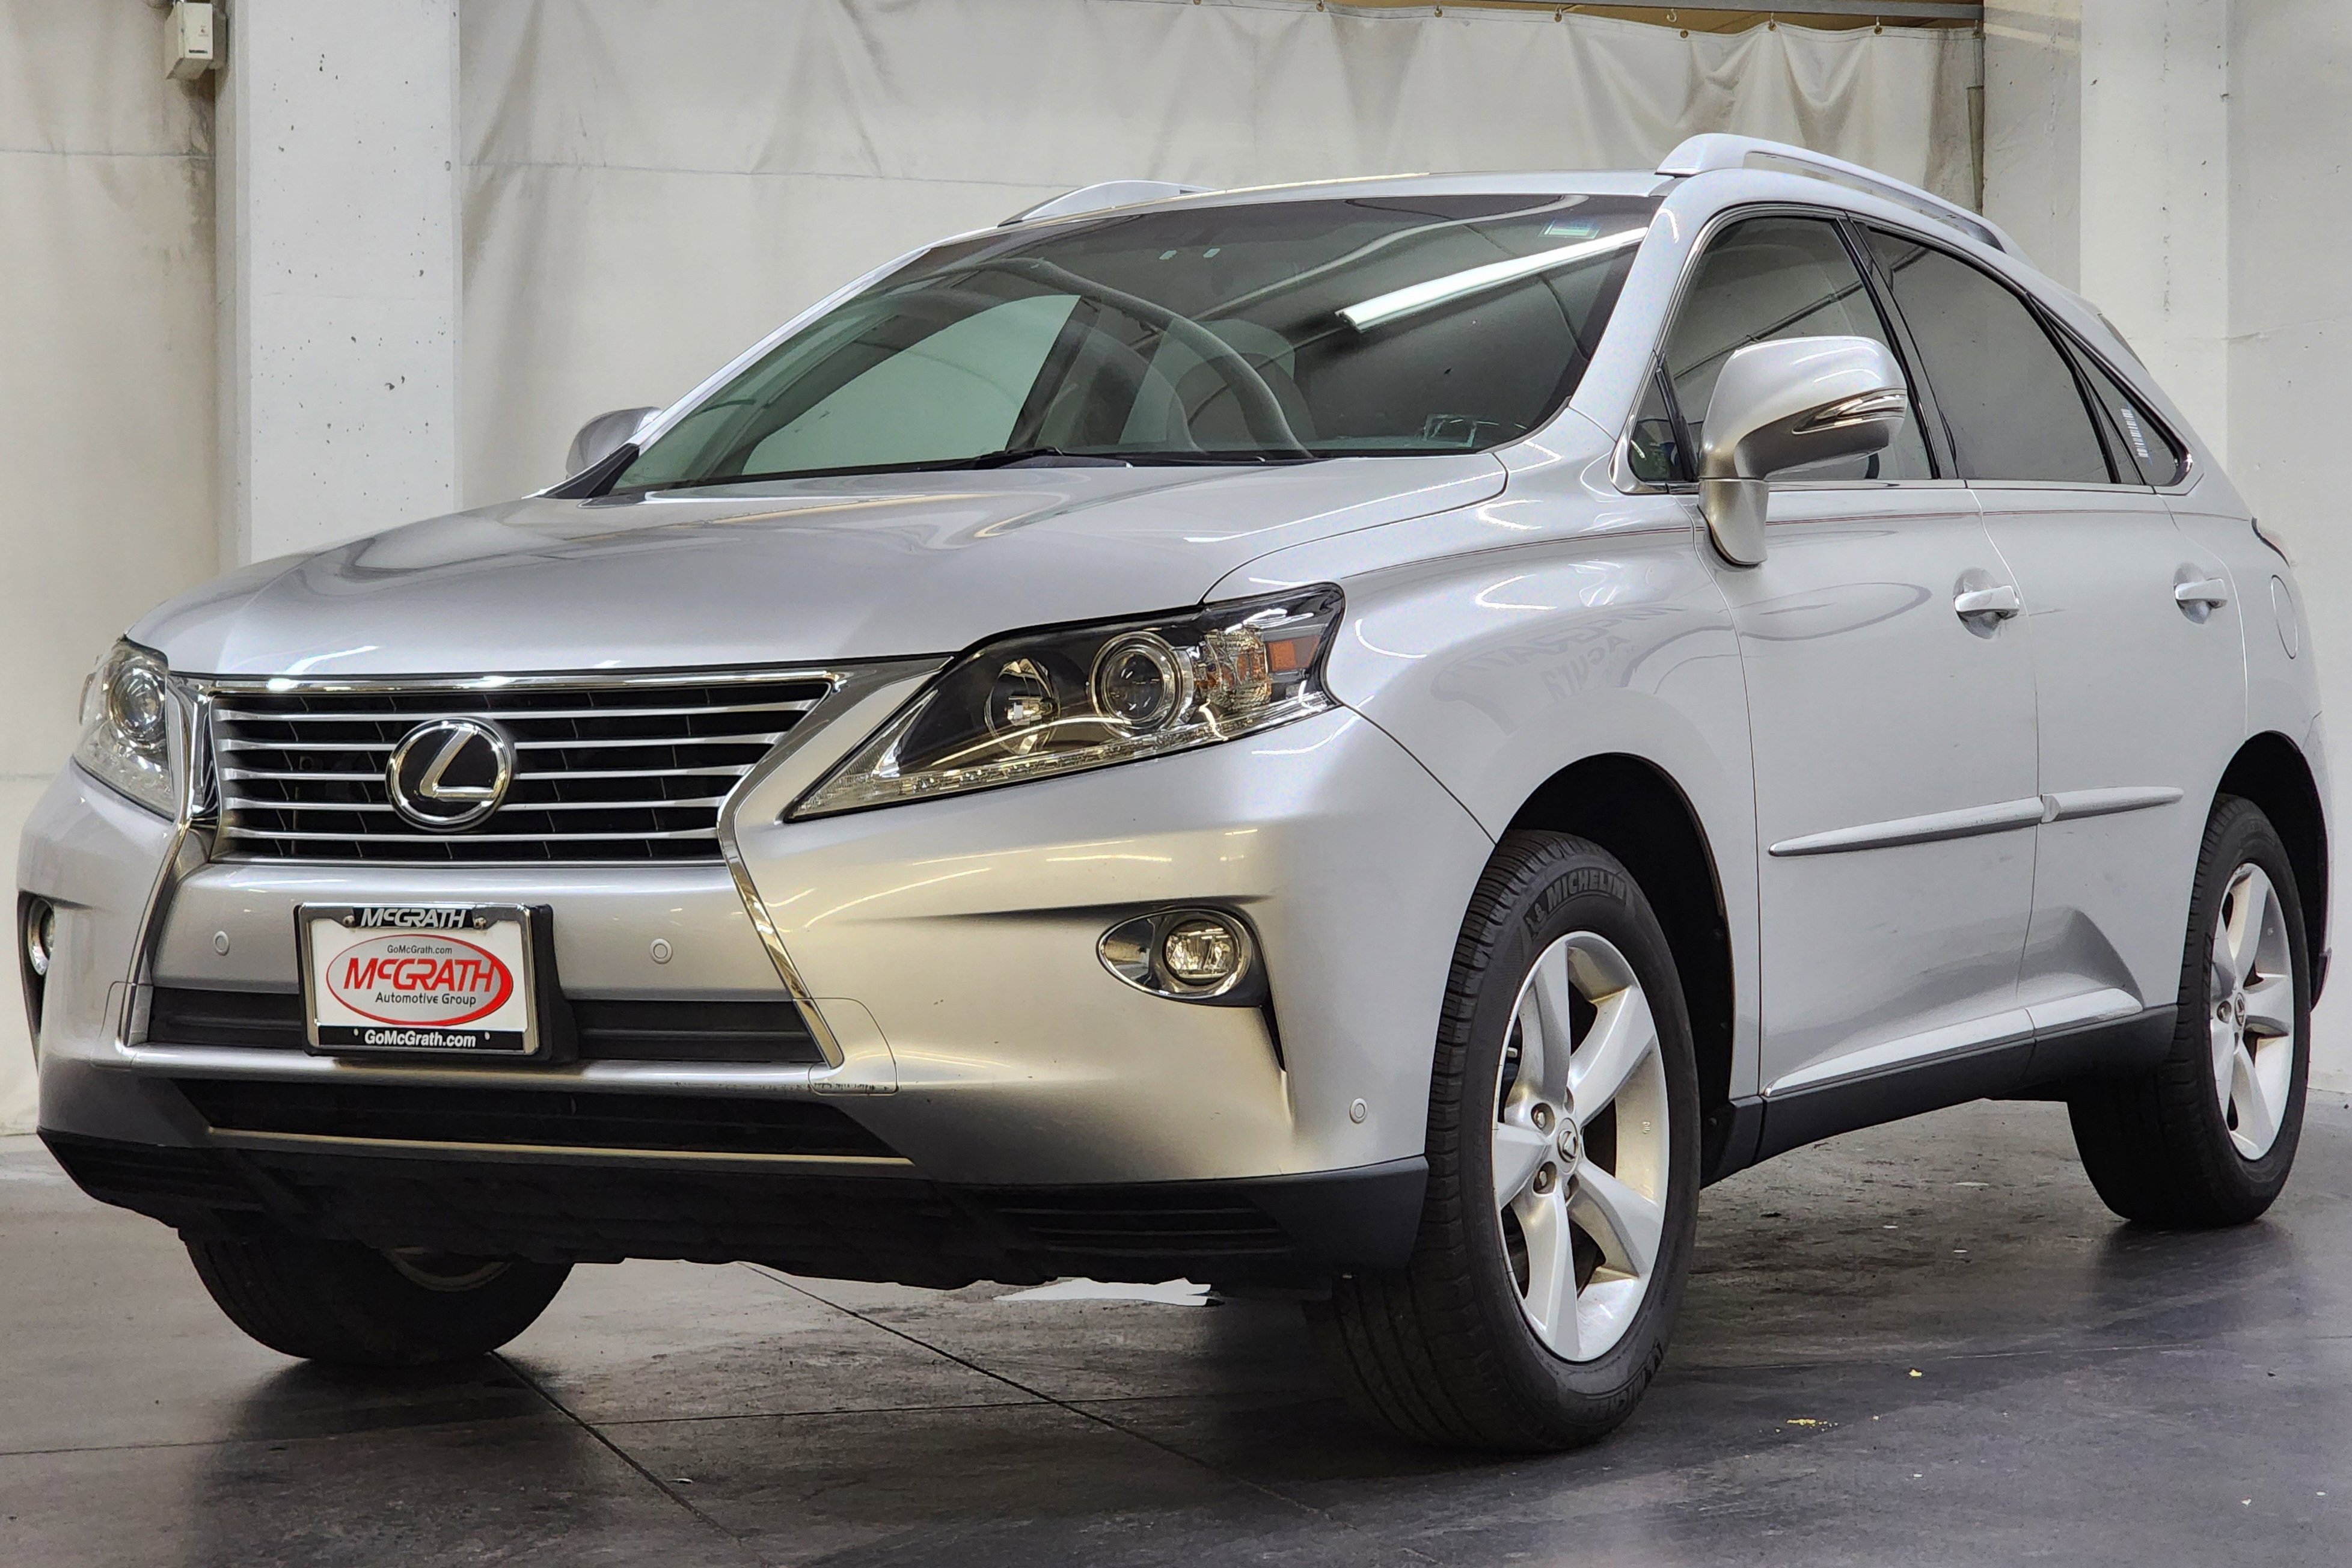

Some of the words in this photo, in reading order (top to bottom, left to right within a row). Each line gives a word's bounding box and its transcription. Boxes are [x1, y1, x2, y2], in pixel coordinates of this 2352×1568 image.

[1546, 869, 1626, 913] MICHELIN
[387, 945, 452, 955] GoMcGrath.com
[375, 992, 438, 1004] Automotive
[442, 993, 476, 1008] Group
[364, 1029, 476, 1047] GoMcGrath.com
